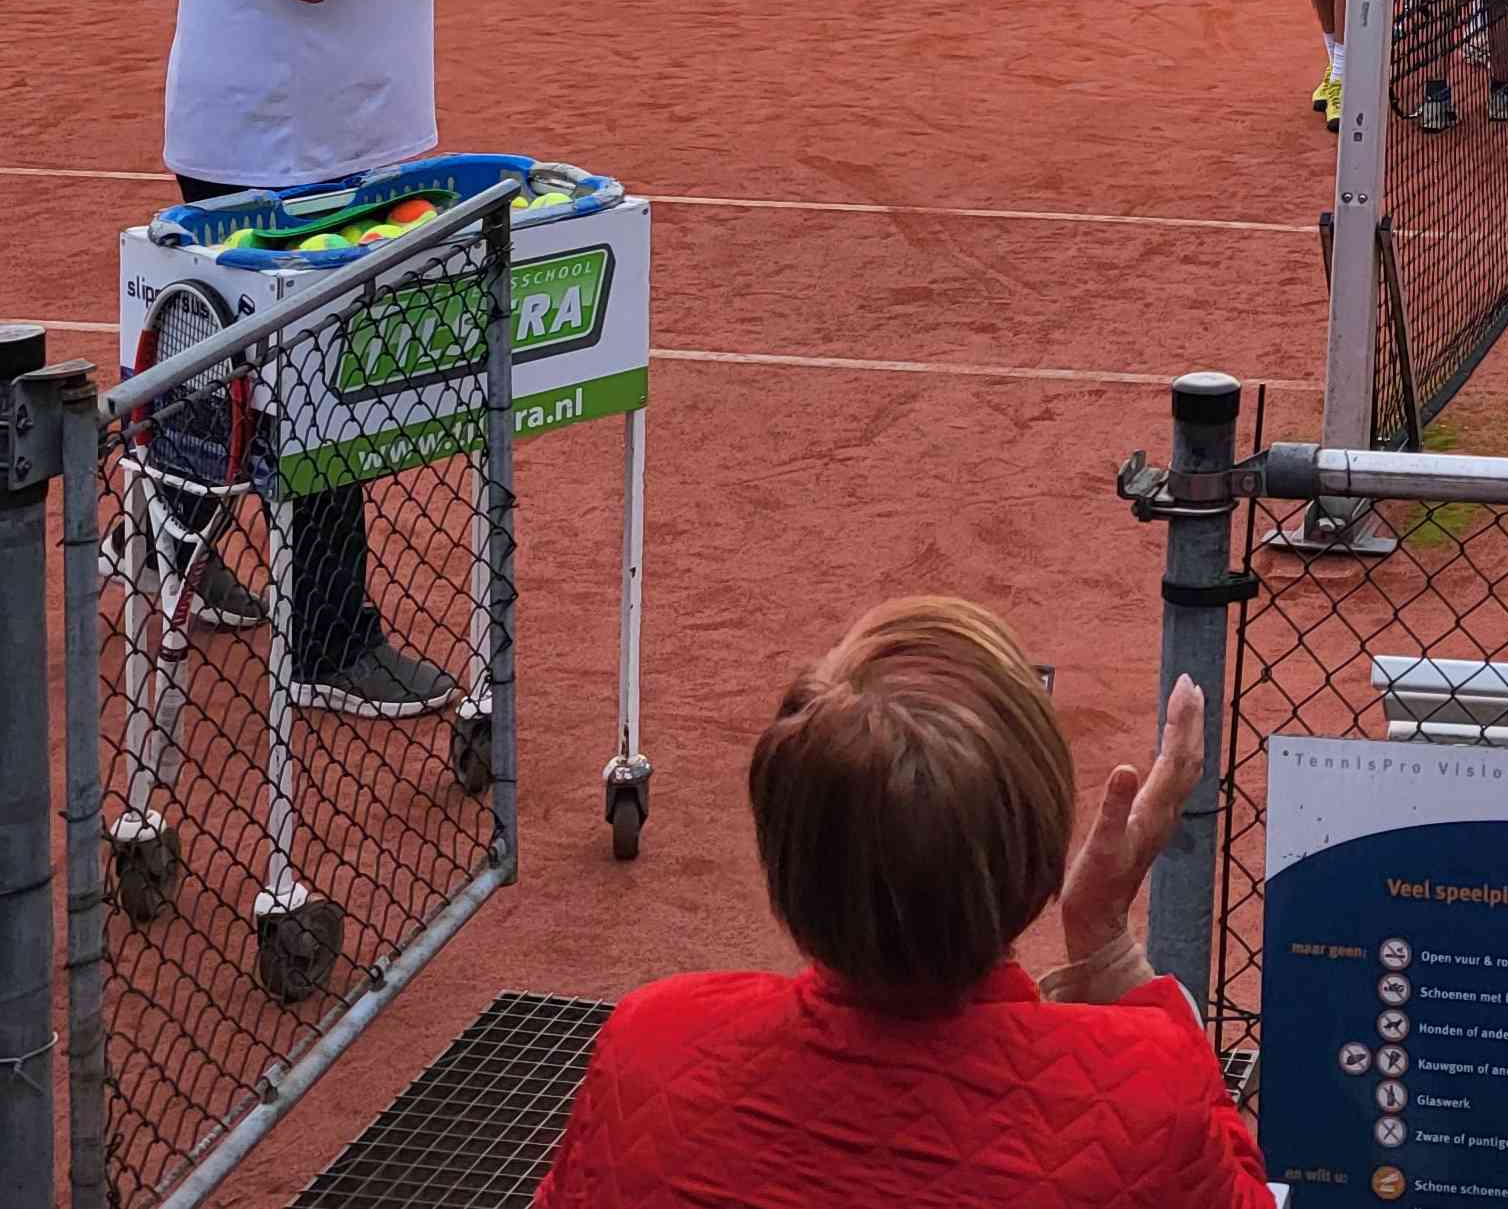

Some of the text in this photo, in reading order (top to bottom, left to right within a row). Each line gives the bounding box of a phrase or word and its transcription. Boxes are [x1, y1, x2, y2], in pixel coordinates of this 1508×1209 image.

[1295, 752, 1422, 775] TennisPro
[1387, 877, 1430, 899] Veel
[1292, 942, 1325, 956] maar
[1421, 950, 1452, 965] Open
[1455, 955, 1481, 967] vuur
[1484, 955, 1493, 967] &
[1420, 986, 1477, 1002] Schoenen
[1480, 991, 1502, 1003] met
[1419, 1023, 1464, 1037] Honden
[1466, 1026, 1478, 1038] of
[1418, 1058, 1474, 1075] Kauwgom
[1477, 1063, 1489, 1075] of
[1416, 1094, 1471, 1109] Glaswerk
[1415, 1130, 1451, 1144] Zware
[1453, 1132, 1465, 1144] of
[1414, 1179, 1458, 1194] Schone
